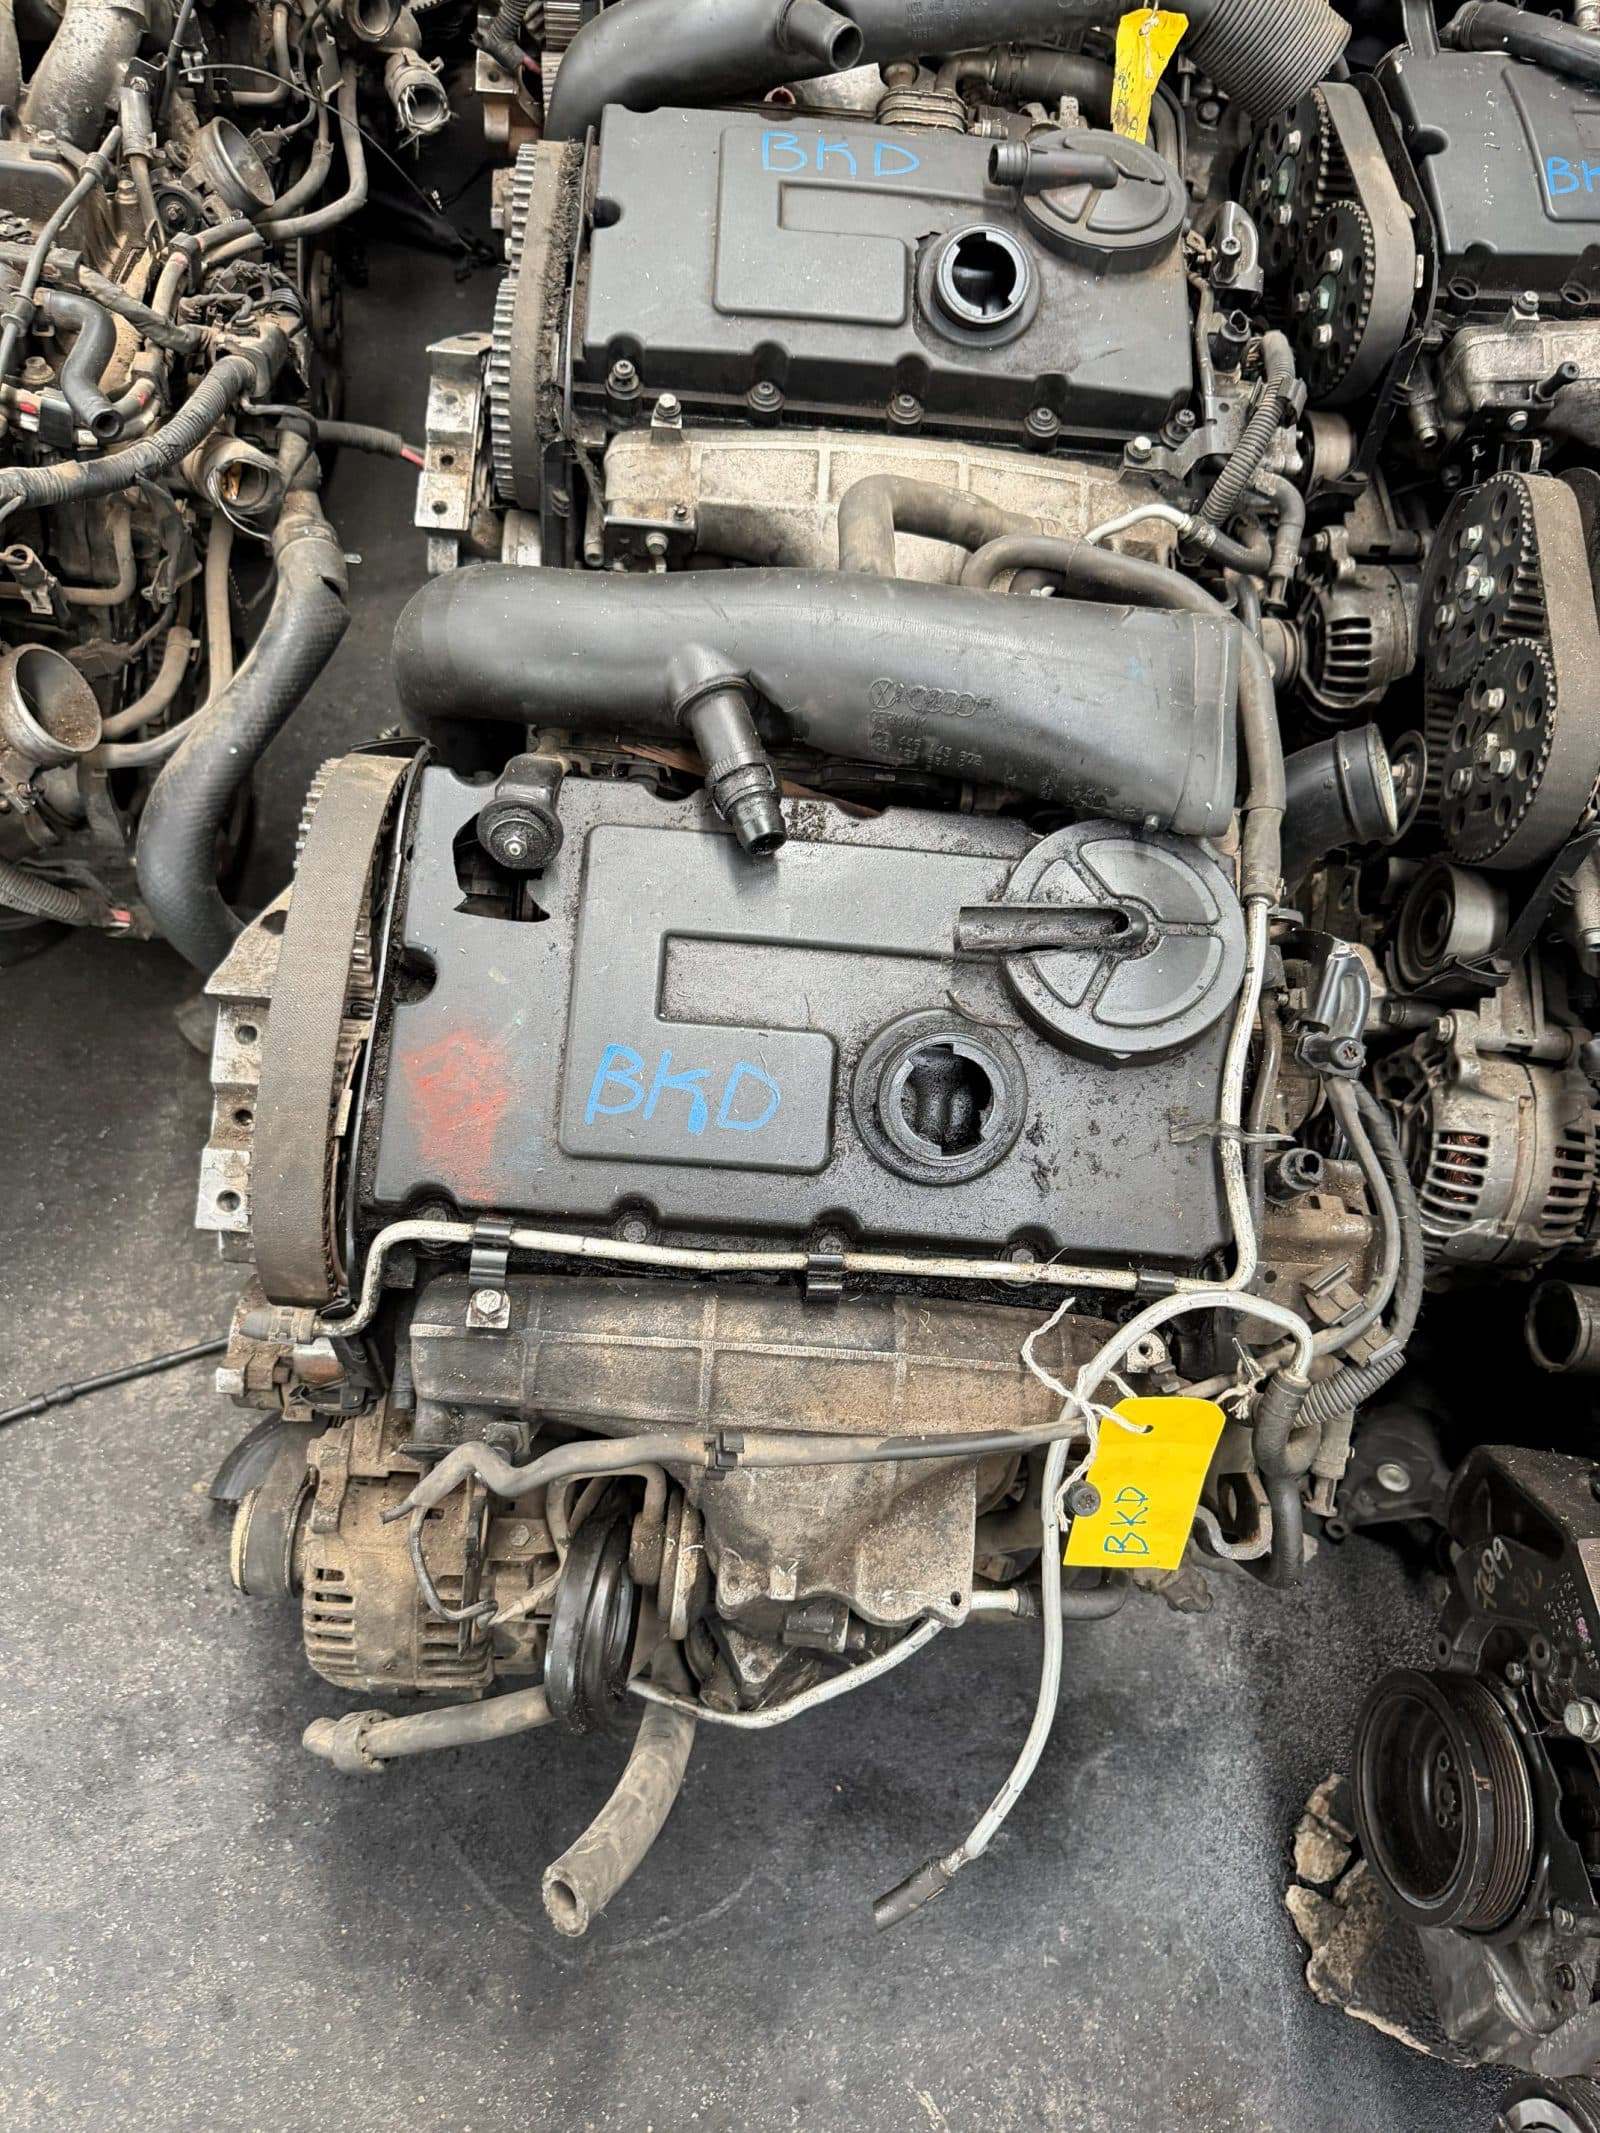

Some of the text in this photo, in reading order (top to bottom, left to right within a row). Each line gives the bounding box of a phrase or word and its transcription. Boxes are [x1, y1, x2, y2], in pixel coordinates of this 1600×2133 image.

[762, 130, 920, 177] BKD
[584, 1043, 780, 1136] BKD
[1104, 1486, 1150, 1554] BKD
